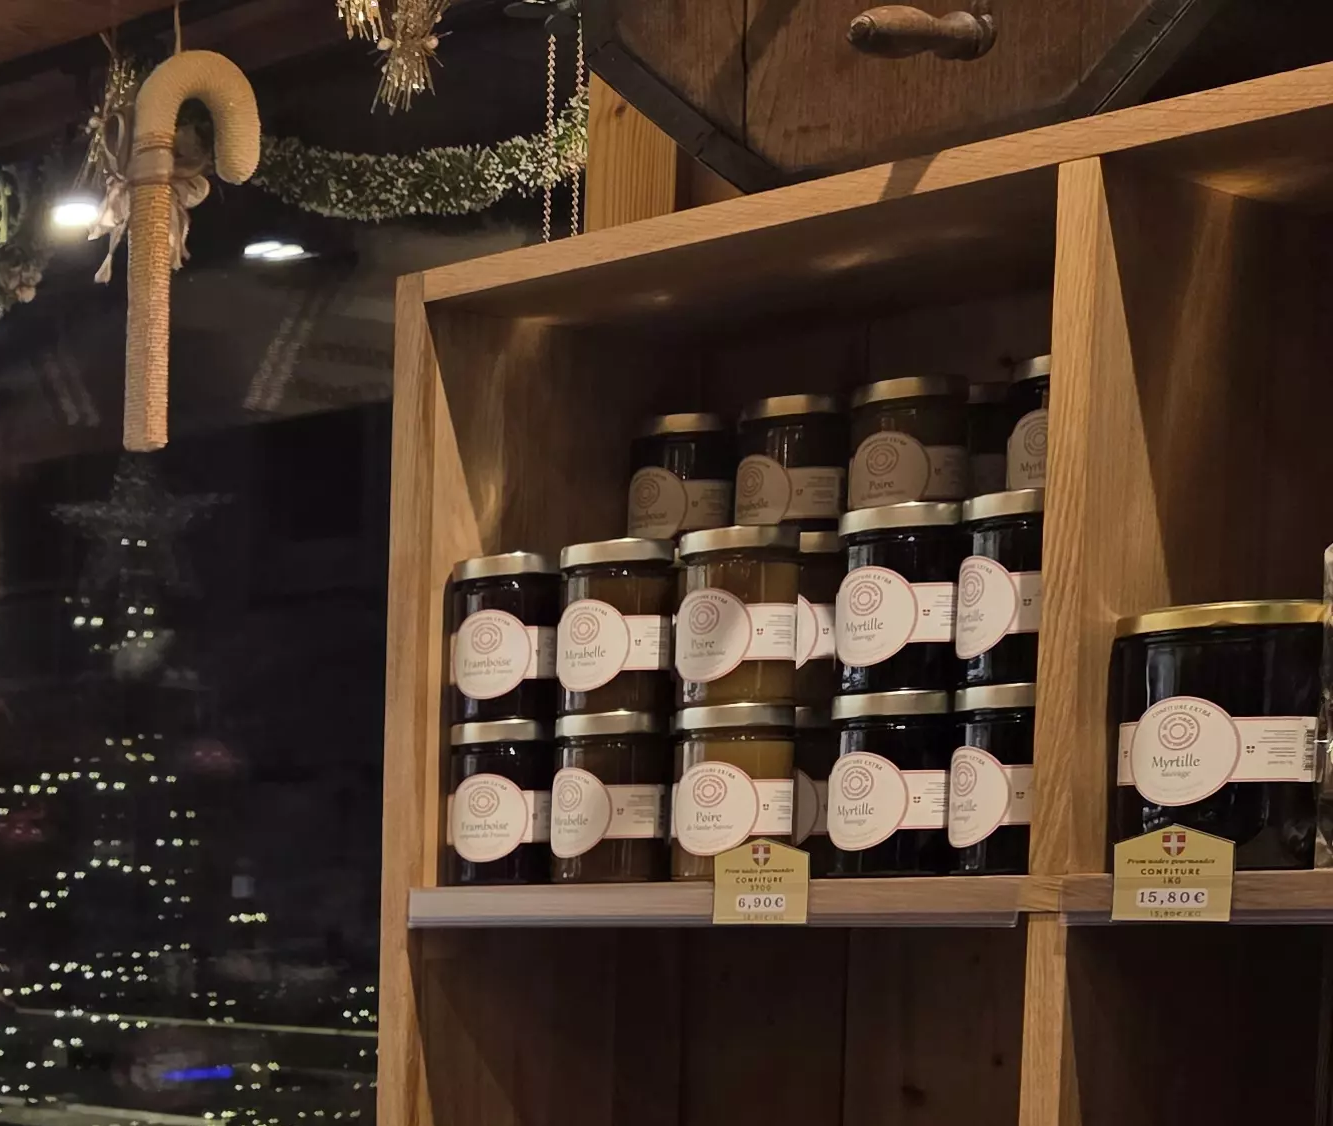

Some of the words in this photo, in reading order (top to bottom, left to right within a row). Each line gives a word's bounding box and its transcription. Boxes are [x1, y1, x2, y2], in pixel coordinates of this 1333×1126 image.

[844, 617, 884, 635] Myrtille
[691, 638, 716, 650] Poire
[565, 645, 606, 660] Mirabelle
[1152, 752, 1201, 772] Myrtille
[696, 811, 722, 823] Poire
[837, 802, 874, 818] Myrtille
[1140, 868, 1201, 876] CONFITURE
[735, 876, 784, 884] CONFITURE
[1139, 891, 1206, 905] 15,80€
